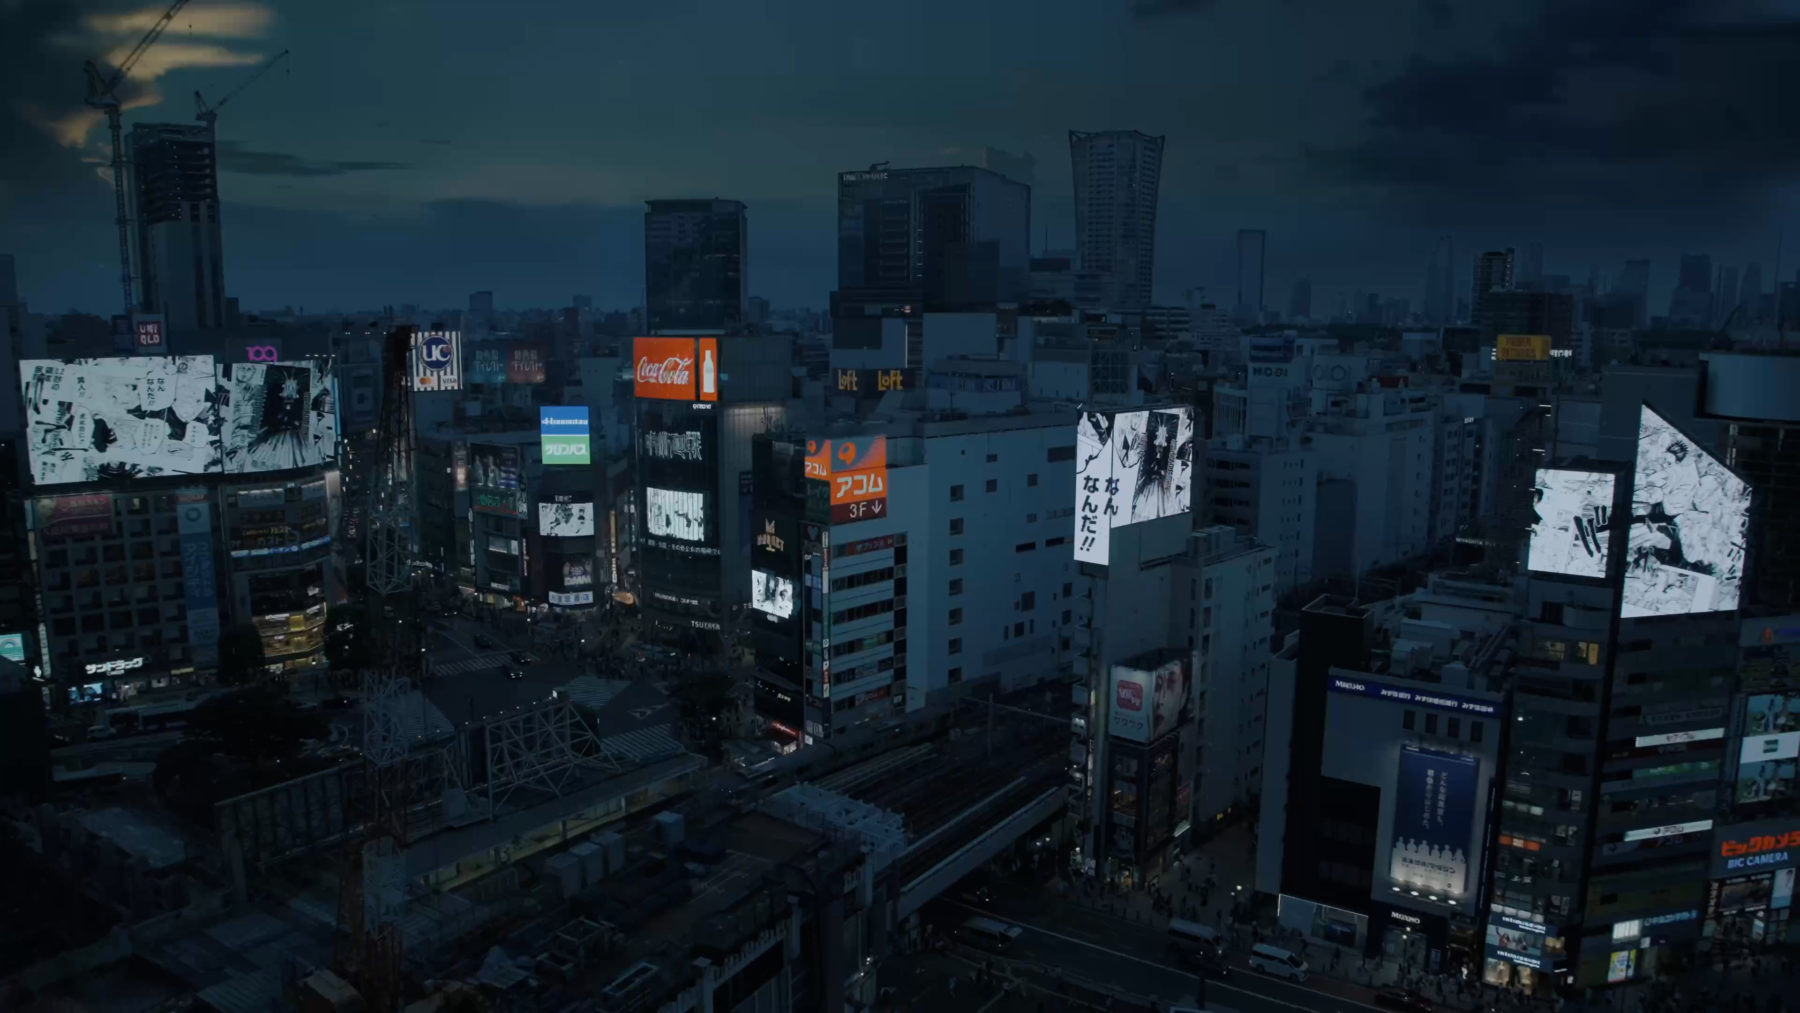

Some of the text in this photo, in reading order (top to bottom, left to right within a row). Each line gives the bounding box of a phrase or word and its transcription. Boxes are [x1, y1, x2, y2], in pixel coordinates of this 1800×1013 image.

[246, 346, 278, 361] 109
[422, 344, 452, 361] UC
[636, 355, 694, 385] Coca-Cola
[836, 472, 884, 498] アコム
[1103, 476, 1120, 516] なん
[850, 502, 868, 518] 3F
[1746, 851, 1789, 867] CAMERA
